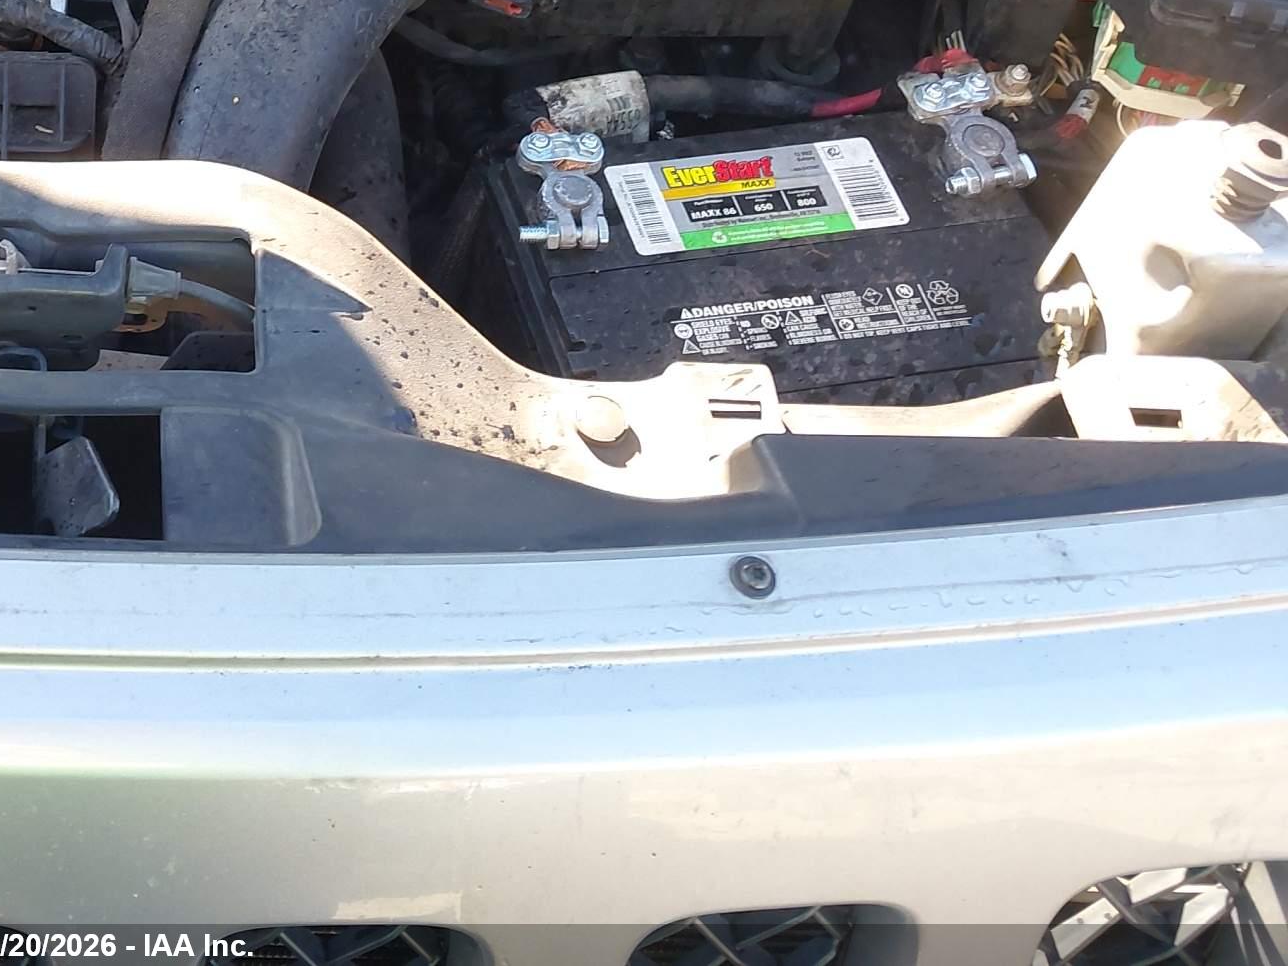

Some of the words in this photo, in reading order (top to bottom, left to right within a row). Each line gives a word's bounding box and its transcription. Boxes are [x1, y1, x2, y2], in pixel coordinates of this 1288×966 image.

[661, 155, 773, 188] EverStart
[741, 178, 772, 189] MAXX
[754, 202, 773, 212] 650
[797, 197, 817, 207] 800
[691, 208, 722, 220] MAXX
[723, 206, 737, 215] 86
[692, 295, 814, 318] DANGER/POISON
